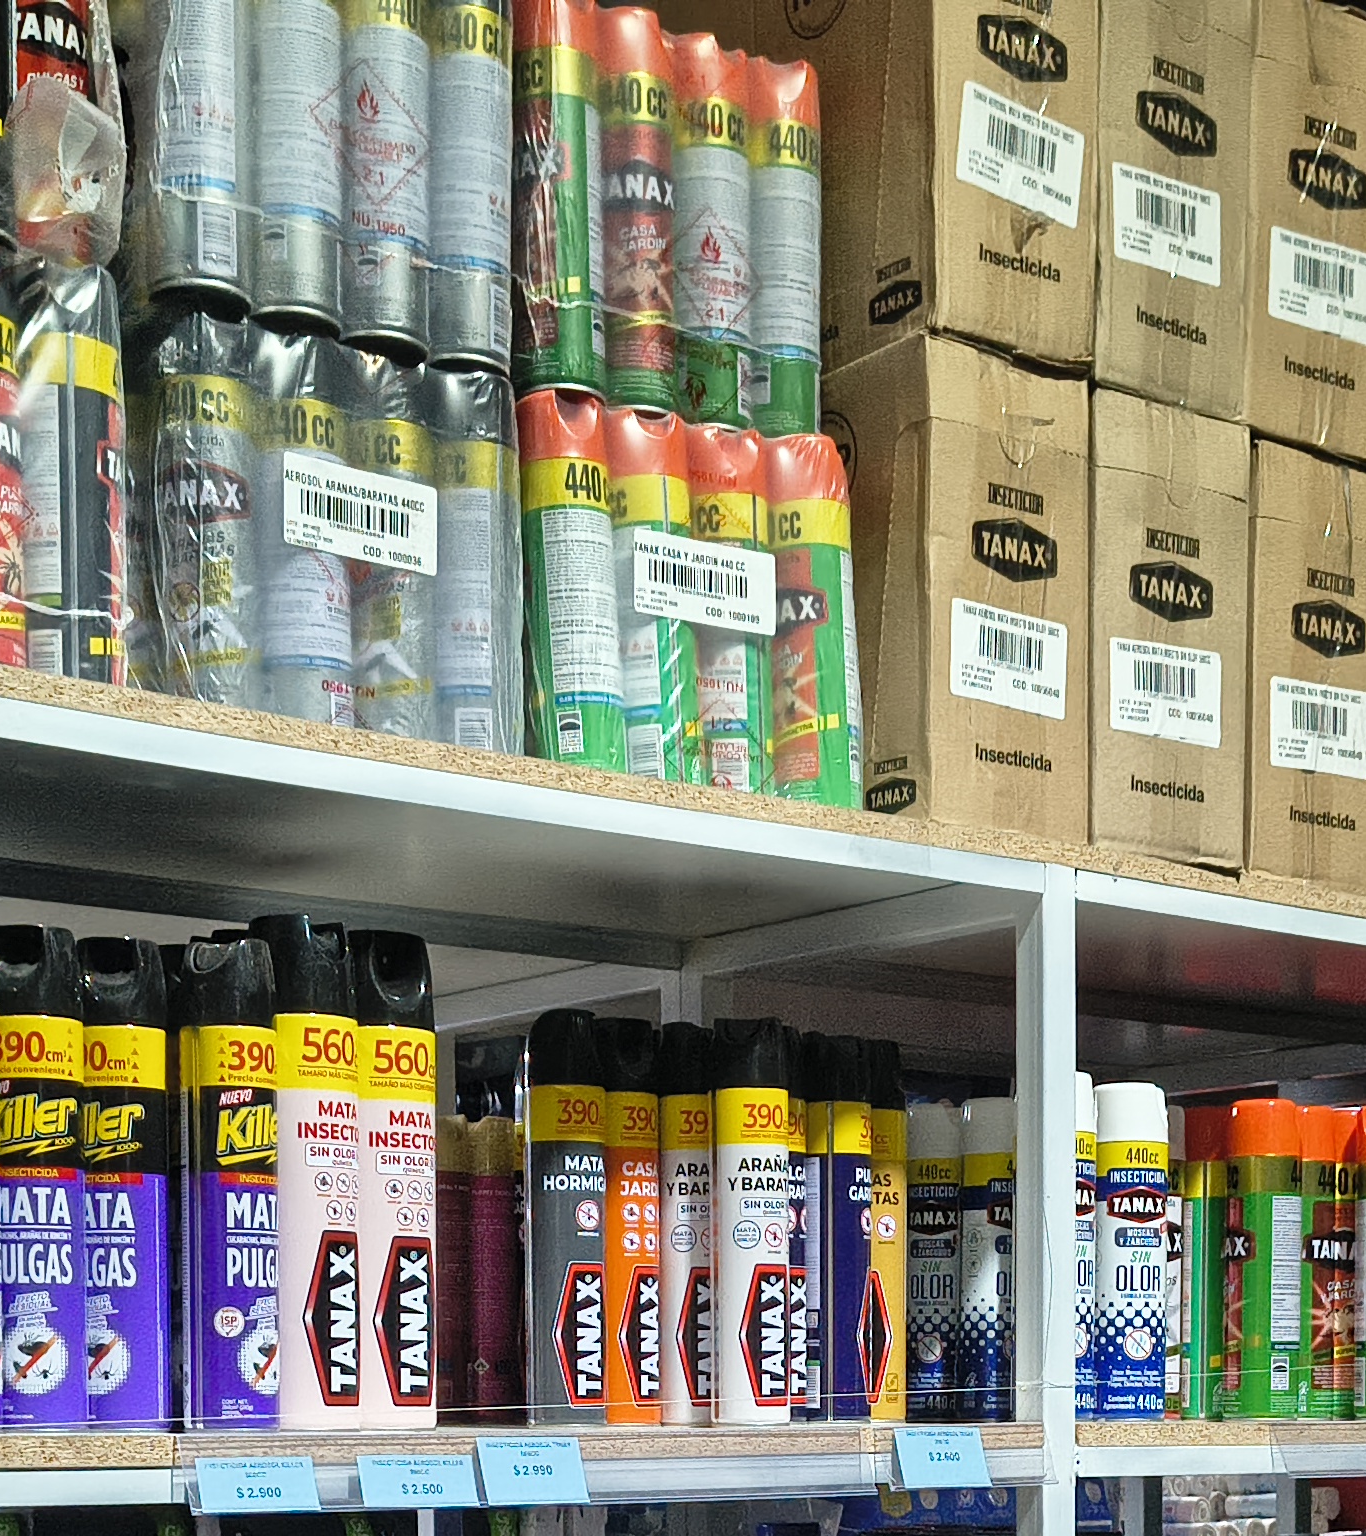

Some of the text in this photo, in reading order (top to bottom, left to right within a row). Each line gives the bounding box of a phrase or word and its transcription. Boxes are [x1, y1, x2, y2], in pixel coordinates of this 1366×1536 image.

[986, 25, 1057, 73] TANAX
[1145, 102, 1207, 148] TANAX
[978, 242, 1061, 285] Insecticida
[1136, 304, 1208, 346] Insecticida
[1284, 355, 1356, 391] Insecticida
[284, 469, 322, 488] AEROSOL
[565, 461, 603, 501] 440
[663, 546, 681, 559] CASA
[981, 531, 1048, 569] TANAX
[1139, 573, 1203, 610] TANAX
[1300, 613, 1357, 645] TANAX
[974, 742, 1052, 773] Insecticida
[1130, 774, 1205, 803] Insecticida
[1289, 804, 1356, 832] Insecticida
[301, 1028, 355, 1068] 560
[373, 1040, 429, 1078] 560
[317, 1100, 357, 1118] MATA
[389, 1108, 432, 1128] MATA
[556, 1099, 600, 1126] 390
[741, 1103, 784, 1130] 390
[379, 1154, 403, 1169] SIN
[564, 1154, 605, 1173] MATA
[1125, 1147, 1159, 1165] 440cc
[1110, 1169, 1165, 1184] INSECTICIDA
[743, 1200, 760, 1211] SIN
[1113, 1197, 1164, 1214] TANAX
[1130, 1250, 1151, 1263] SIN
[1116, 1264, 1160, 1293] OLOR
[329, 1252, 357, 1394] TANAX
[399, 1261, 429, 1394] TANAX
[523, 1464, 553, 1476] 2.990
[412, 1483, 444, 1495] 2.500
